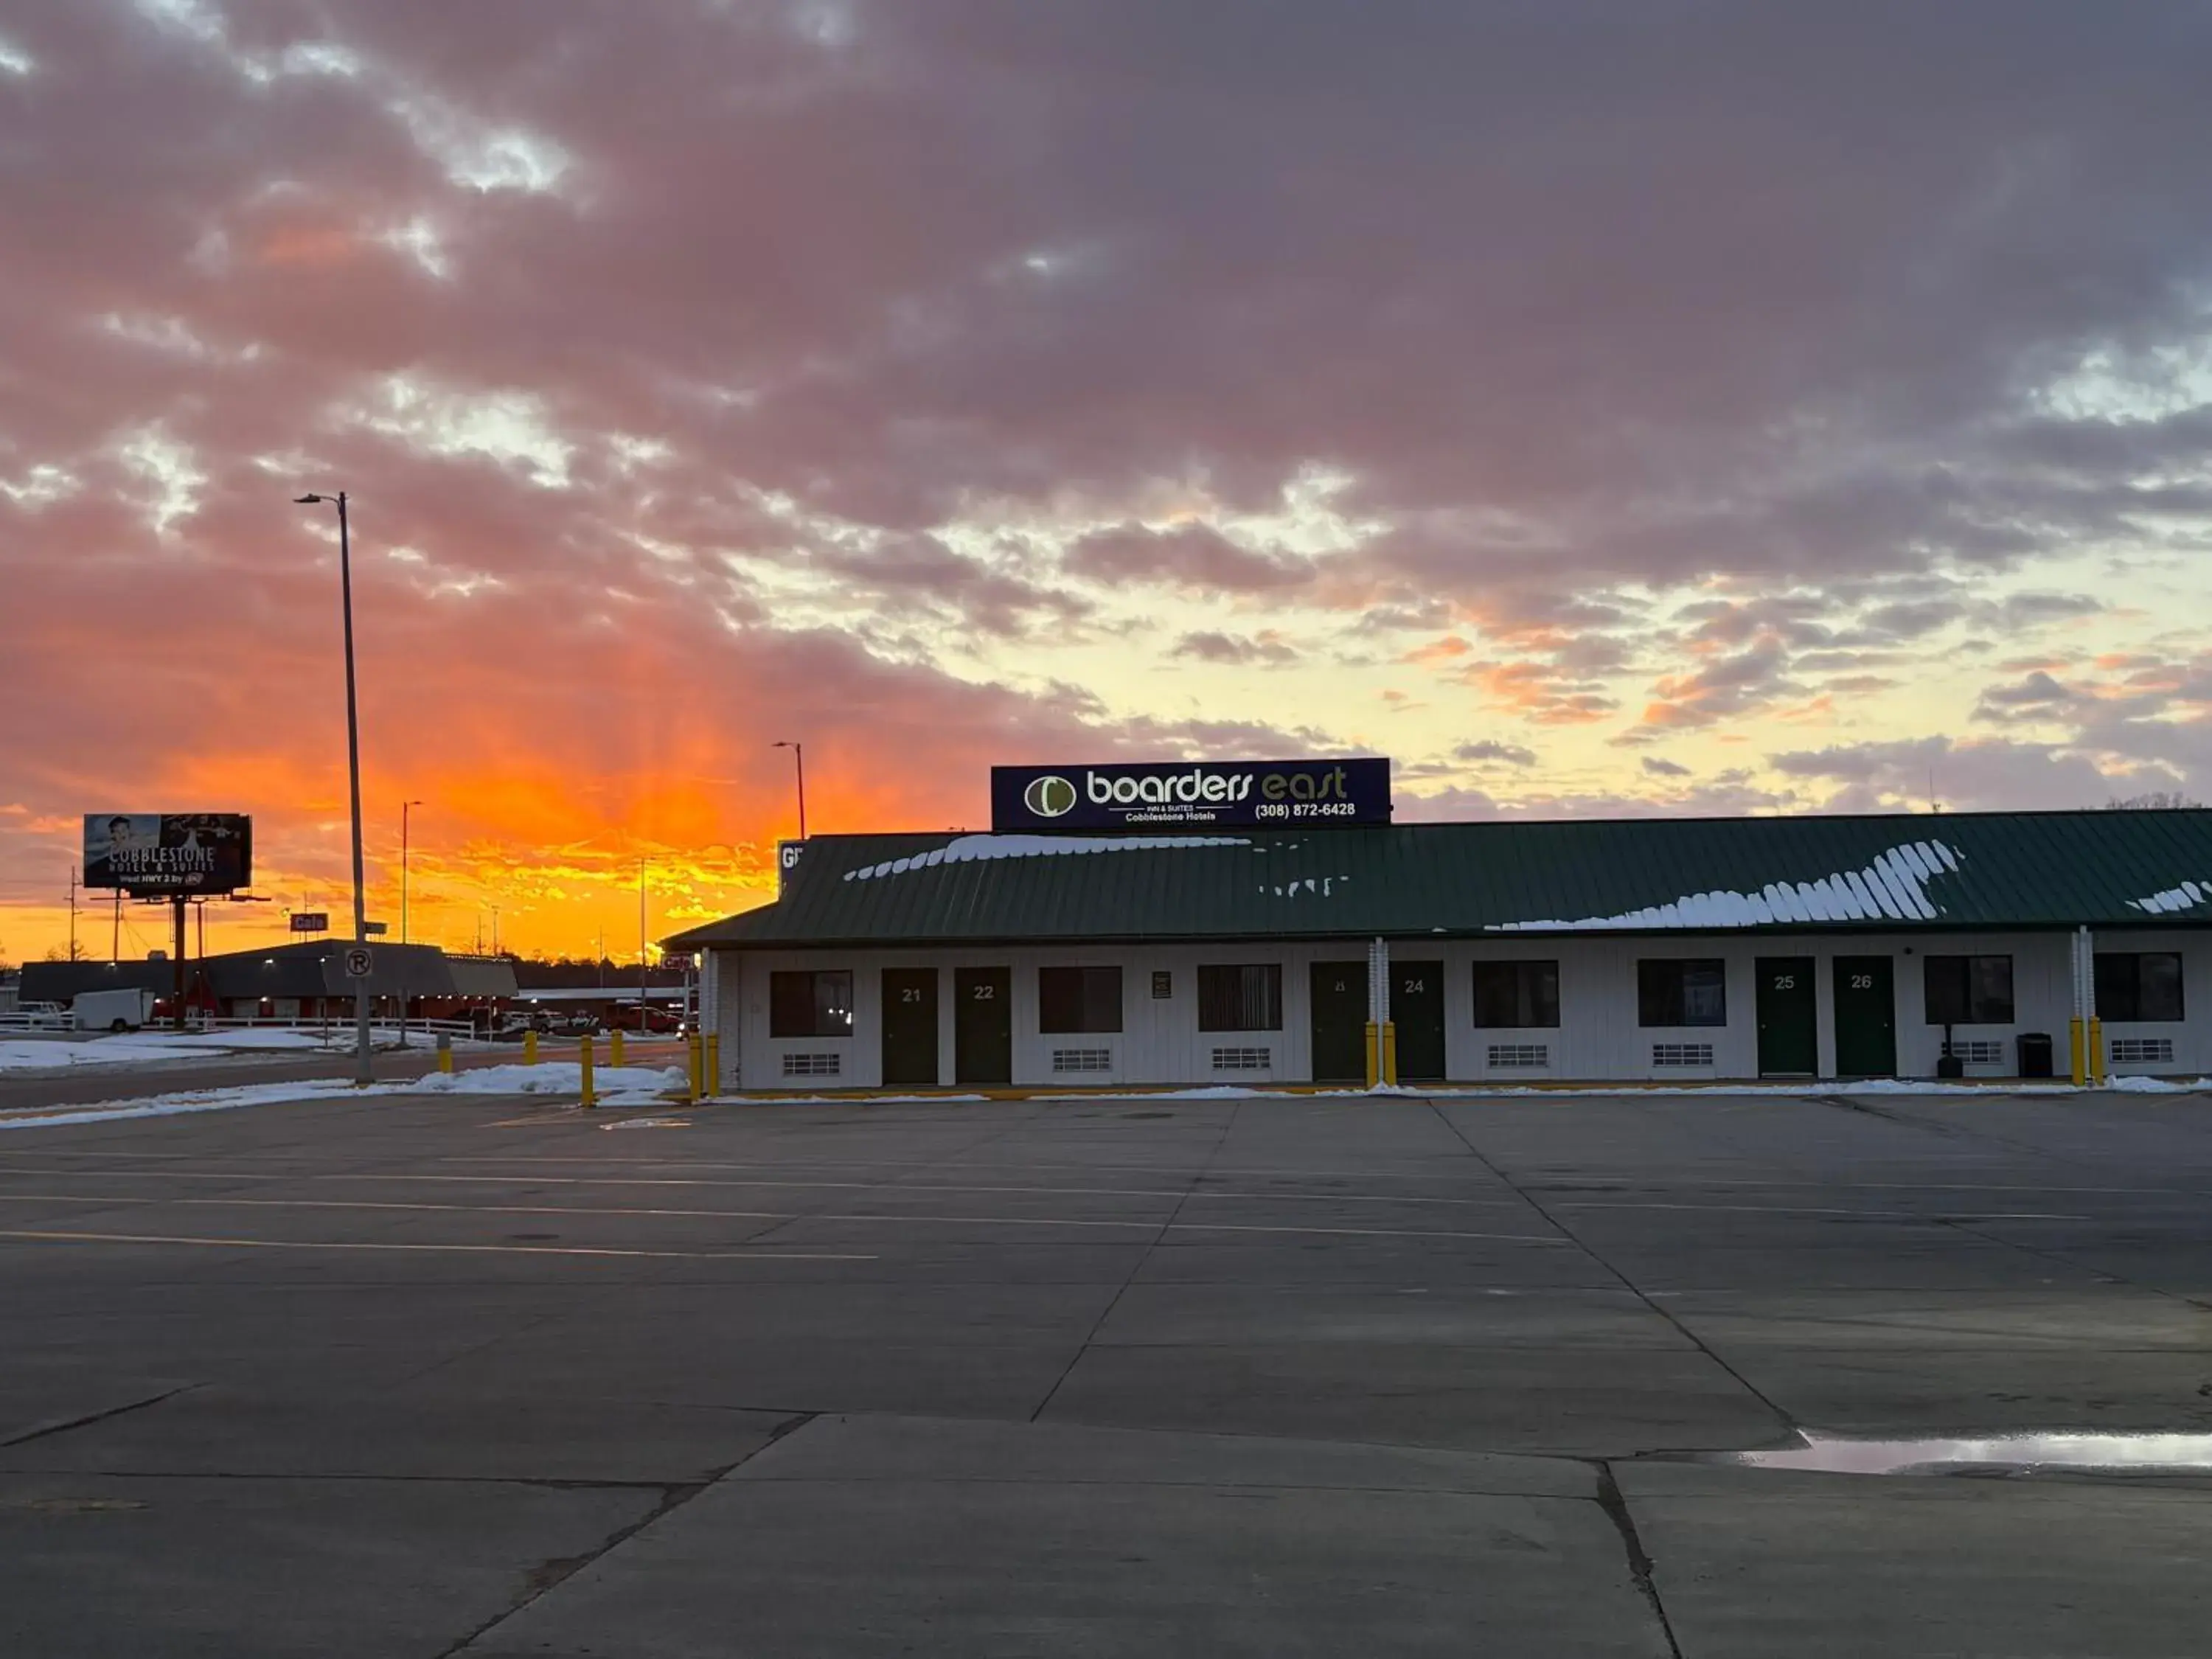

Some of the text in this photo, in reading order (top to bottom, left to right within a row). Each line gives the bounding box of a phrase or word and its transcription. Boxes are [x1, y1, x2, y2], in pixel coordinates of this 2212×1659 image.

[1087, 766, 1348, 804] boarders east
[1125, 810, 1217, 822] Cobblestone Hotels
[1255, 803, 1356, 820] (308) 872-6428
[108, 846, 215, 863] COBBLESTONE
[1404, 979, 1425, 994] 24
[1773, 975, 1795, 990] 25
[1851, 974, 1872, 989] 26
[902, 988, 921, 1002] 21
[973, 985, 995, 1000] 22
